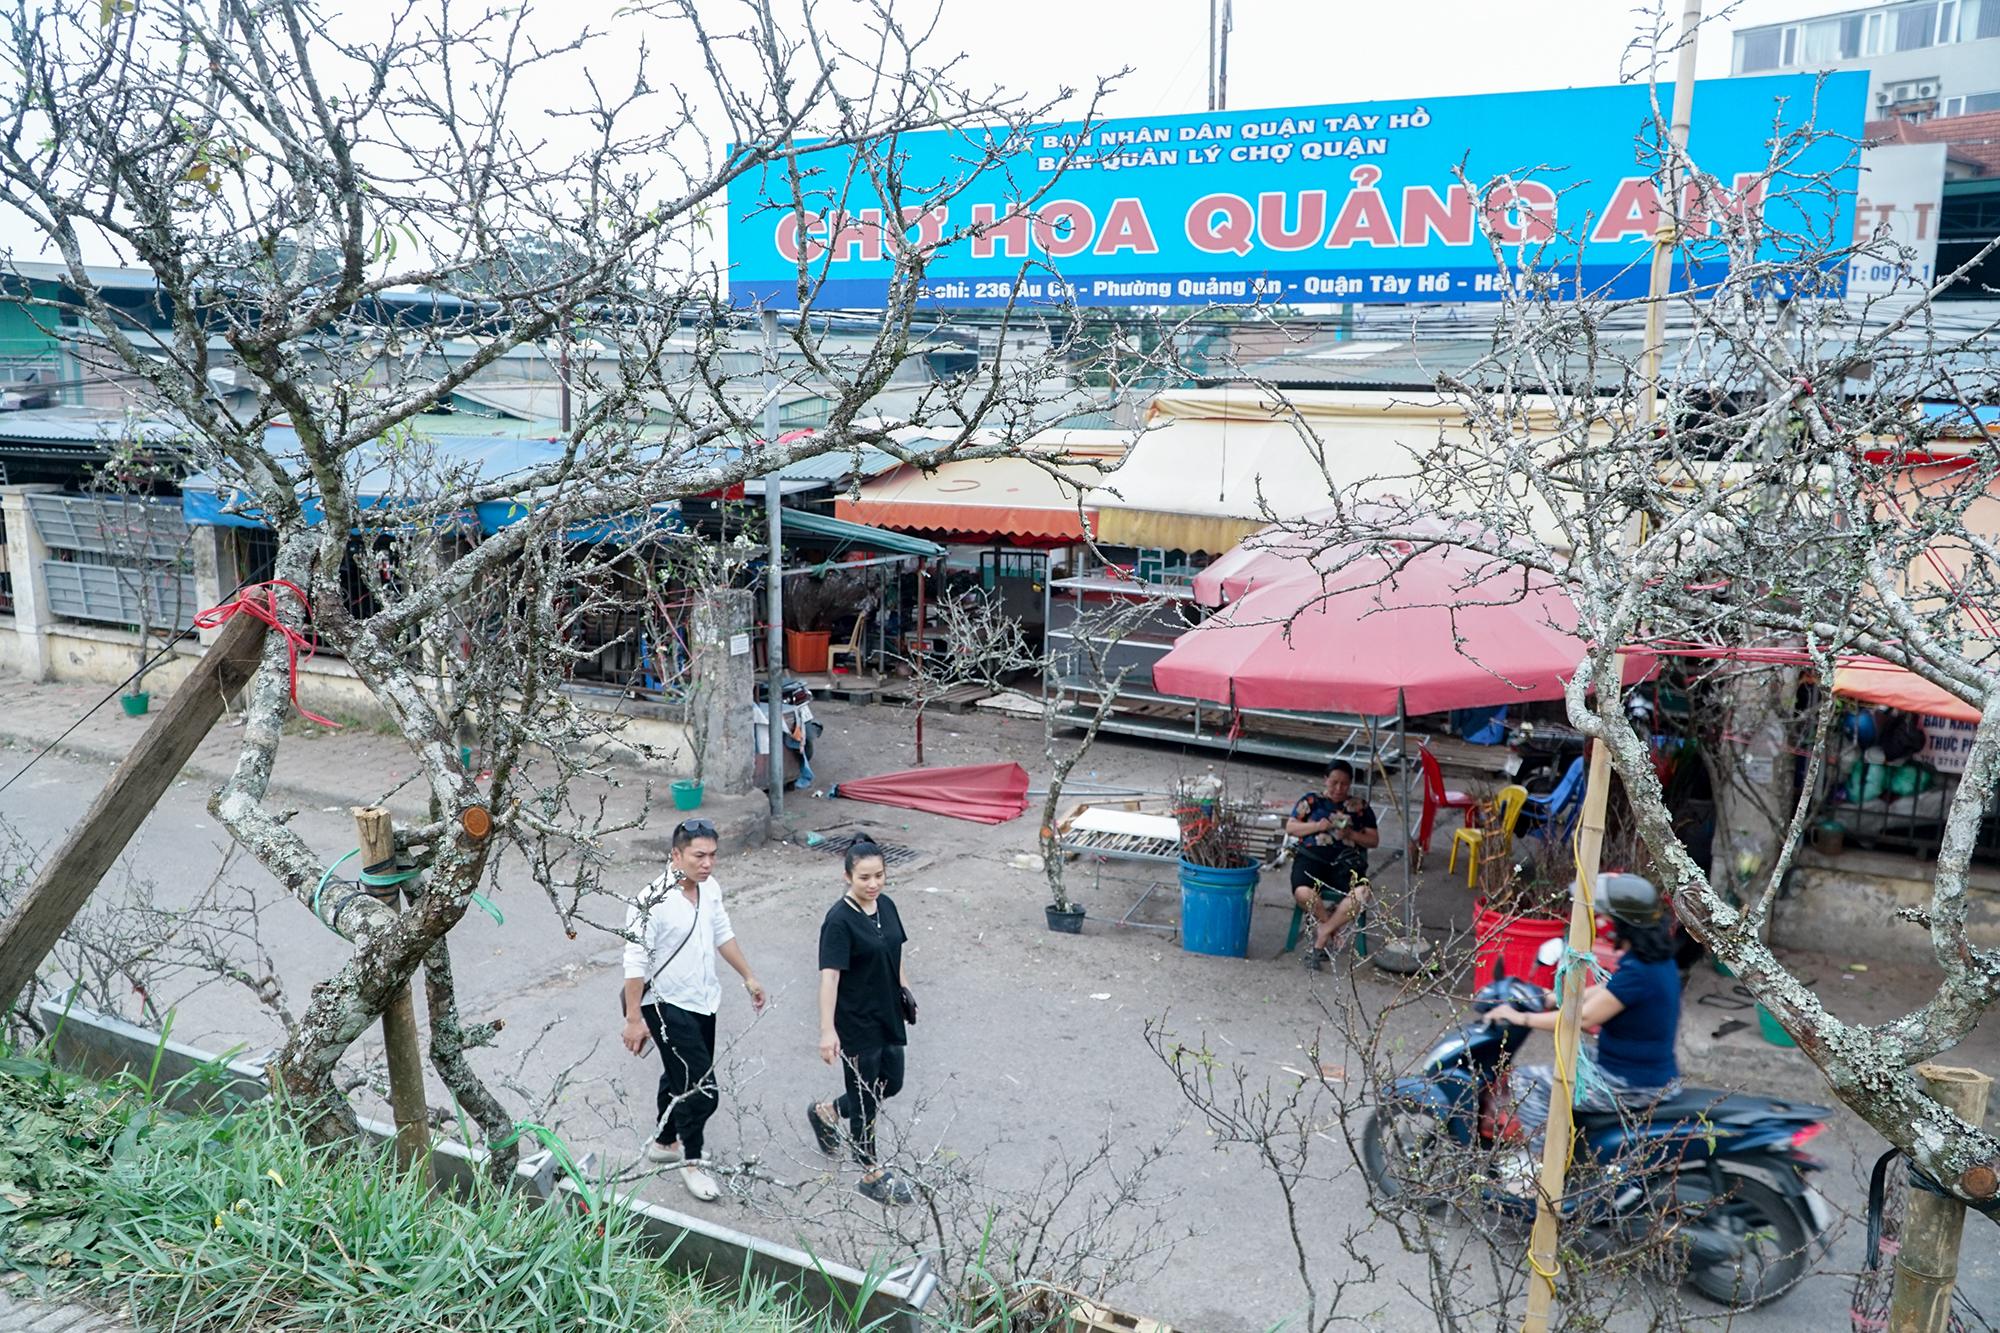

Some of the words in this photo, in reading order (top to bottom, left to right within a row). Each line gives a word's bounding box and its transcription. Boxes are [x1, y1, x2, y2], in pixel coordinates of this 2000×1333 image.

[1042, 134, 1092, 149] BAN
[1101, 128, 1170, 146] NHÂN
[1179, 124, 1232, 141] DÂN
[1241, 118, 1315, 139] QUẬN
[1324, 114, 1380, 132] TÂY
[1389, 107, 1431, 129] HỒ
[1038, 155, 1092, 172] BAN
[1188, 144, 1221, 164] LÝ
[1230, 143, 1294, 163] CHỢ
[1301, 137, 1387, 160] QUẬN
[775, 206, 949, 268] CHỢ
[971, 198, 1159, 258] HOA
[1185, 164, 1556, 256] QUẢNG
[1590, 172, 1770, 243] AN
[975, 282, 1011, 298] 236
[1093, 279, 1171, 297] Phường
[1178, 278, 1246, 296] Quảng
[1252, 278, 1281, 294] An
[1304, 276, 1363, 296] Quận
[1370, 274, 1411, 295] Tây
[1418, 272, 1451, 292] Hồ
